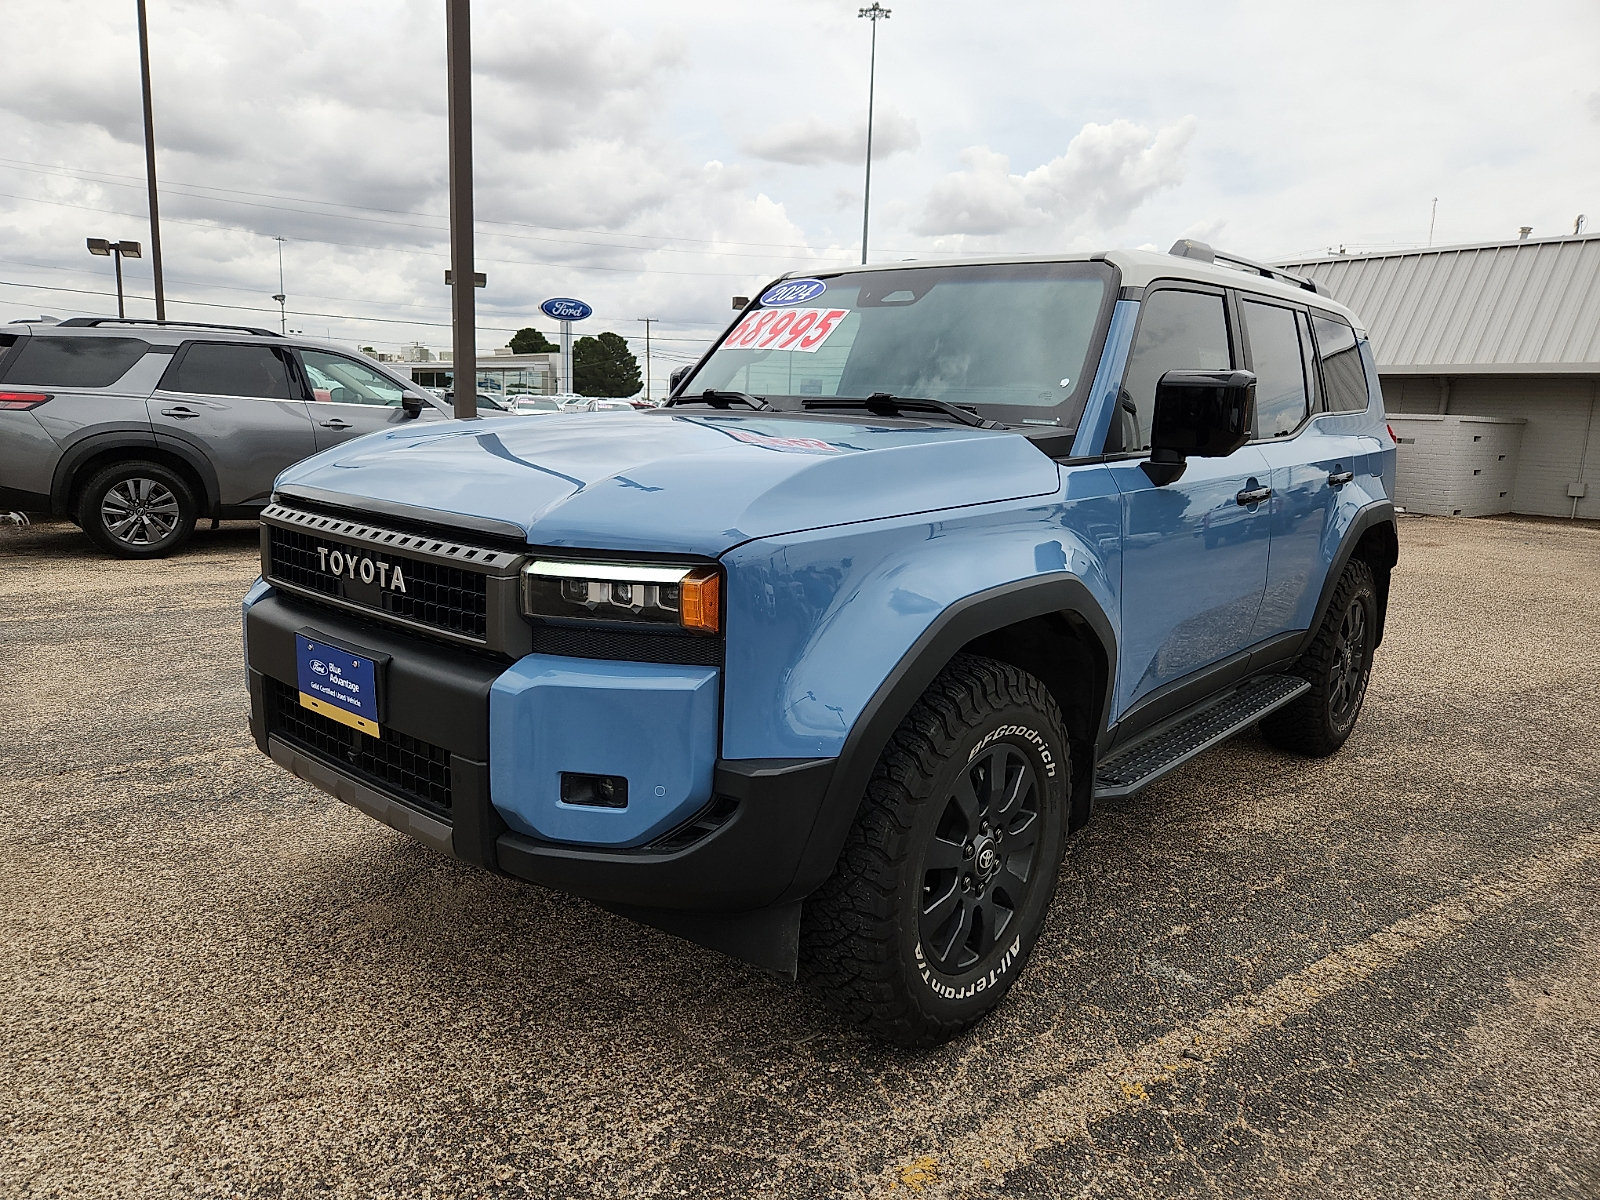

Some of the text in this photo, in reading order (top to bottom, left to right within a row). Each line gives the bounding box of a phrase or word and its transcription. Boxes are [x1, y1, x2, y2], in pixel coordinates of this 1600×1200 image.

[764, 283, 822, 303] 2024
[552, 301, 583, 317] Ford
[723, 309, 847, 350] 68995
[317, 546, 406, 593] TOYOTA
[328, 662, 342, 676] Blue
[310, 681, 320, 690] Gold
[336, 691, 347, 702] Used
[329, 673, 360, 693] Advantage
[967, 724, 1056, 778] BFGoodrich
[931, 933, 1020, 999] All-Terrain
